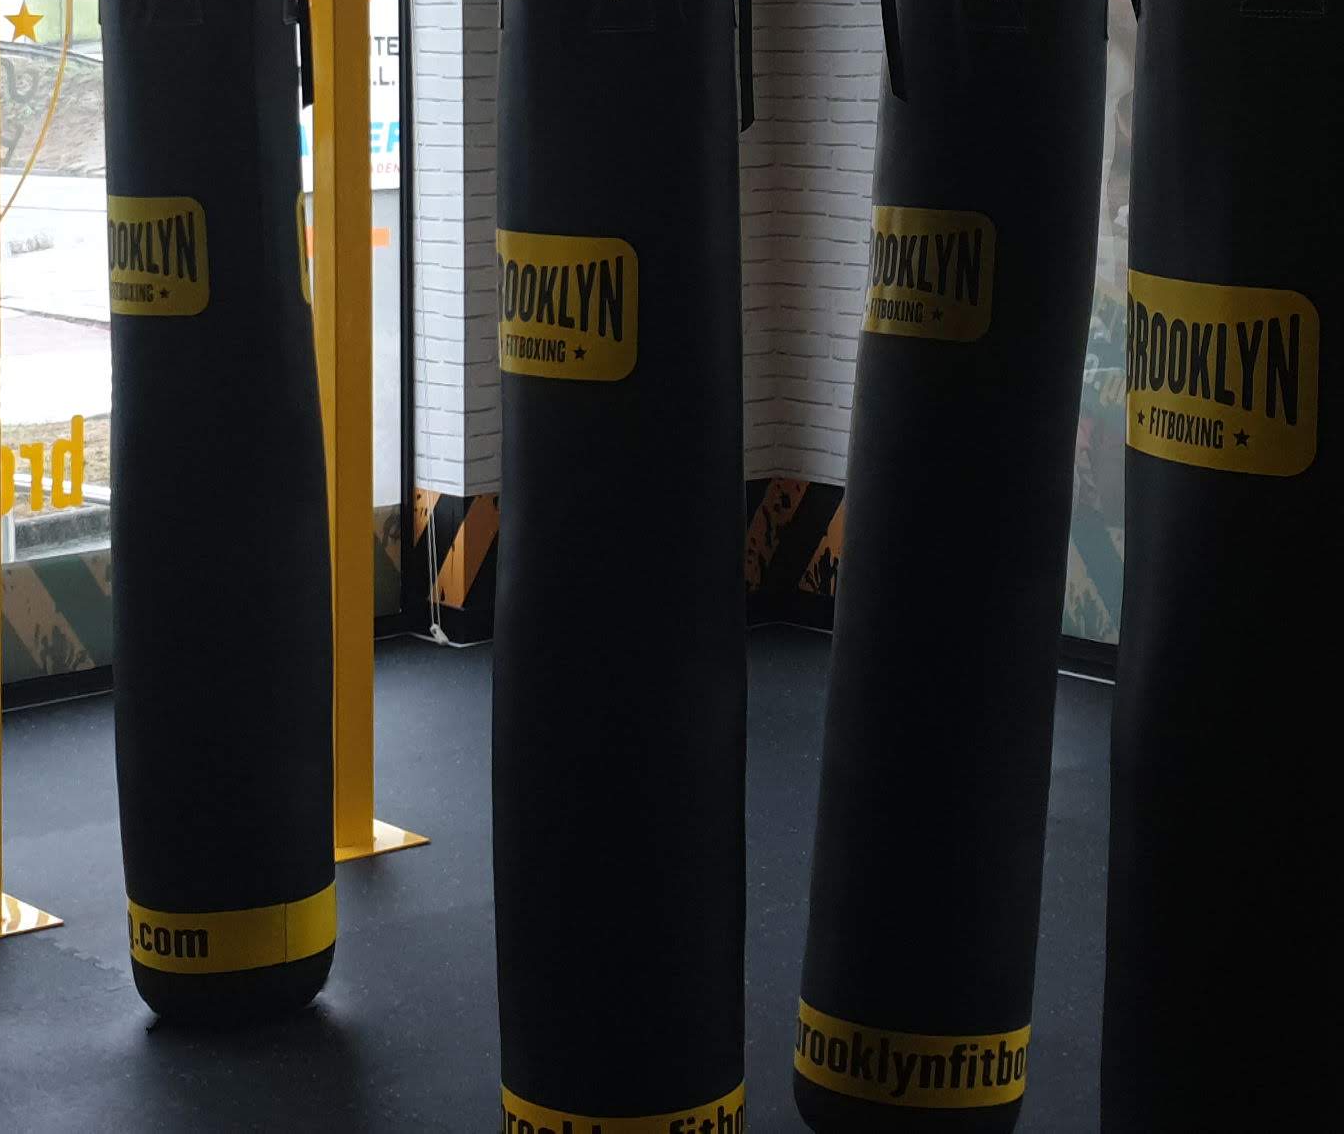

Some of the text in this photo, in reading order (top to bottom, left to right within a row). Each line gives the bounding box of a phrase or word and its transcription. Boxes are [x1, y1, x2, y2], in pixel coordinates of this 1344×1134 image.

[108, 211, 197, 283] OOKLYN
[868, 227, 982, 307] OOKLYN
[498, 254, 624, 343] OOKLYN
[506, 334, 566, 363] FITBOXING
[1126, 293, 1300, 427] BROOKLYN
[1149, 406, 1224, 449] FITBOXING
[797, 1016, 1029, 1098] rooklynfitbo
